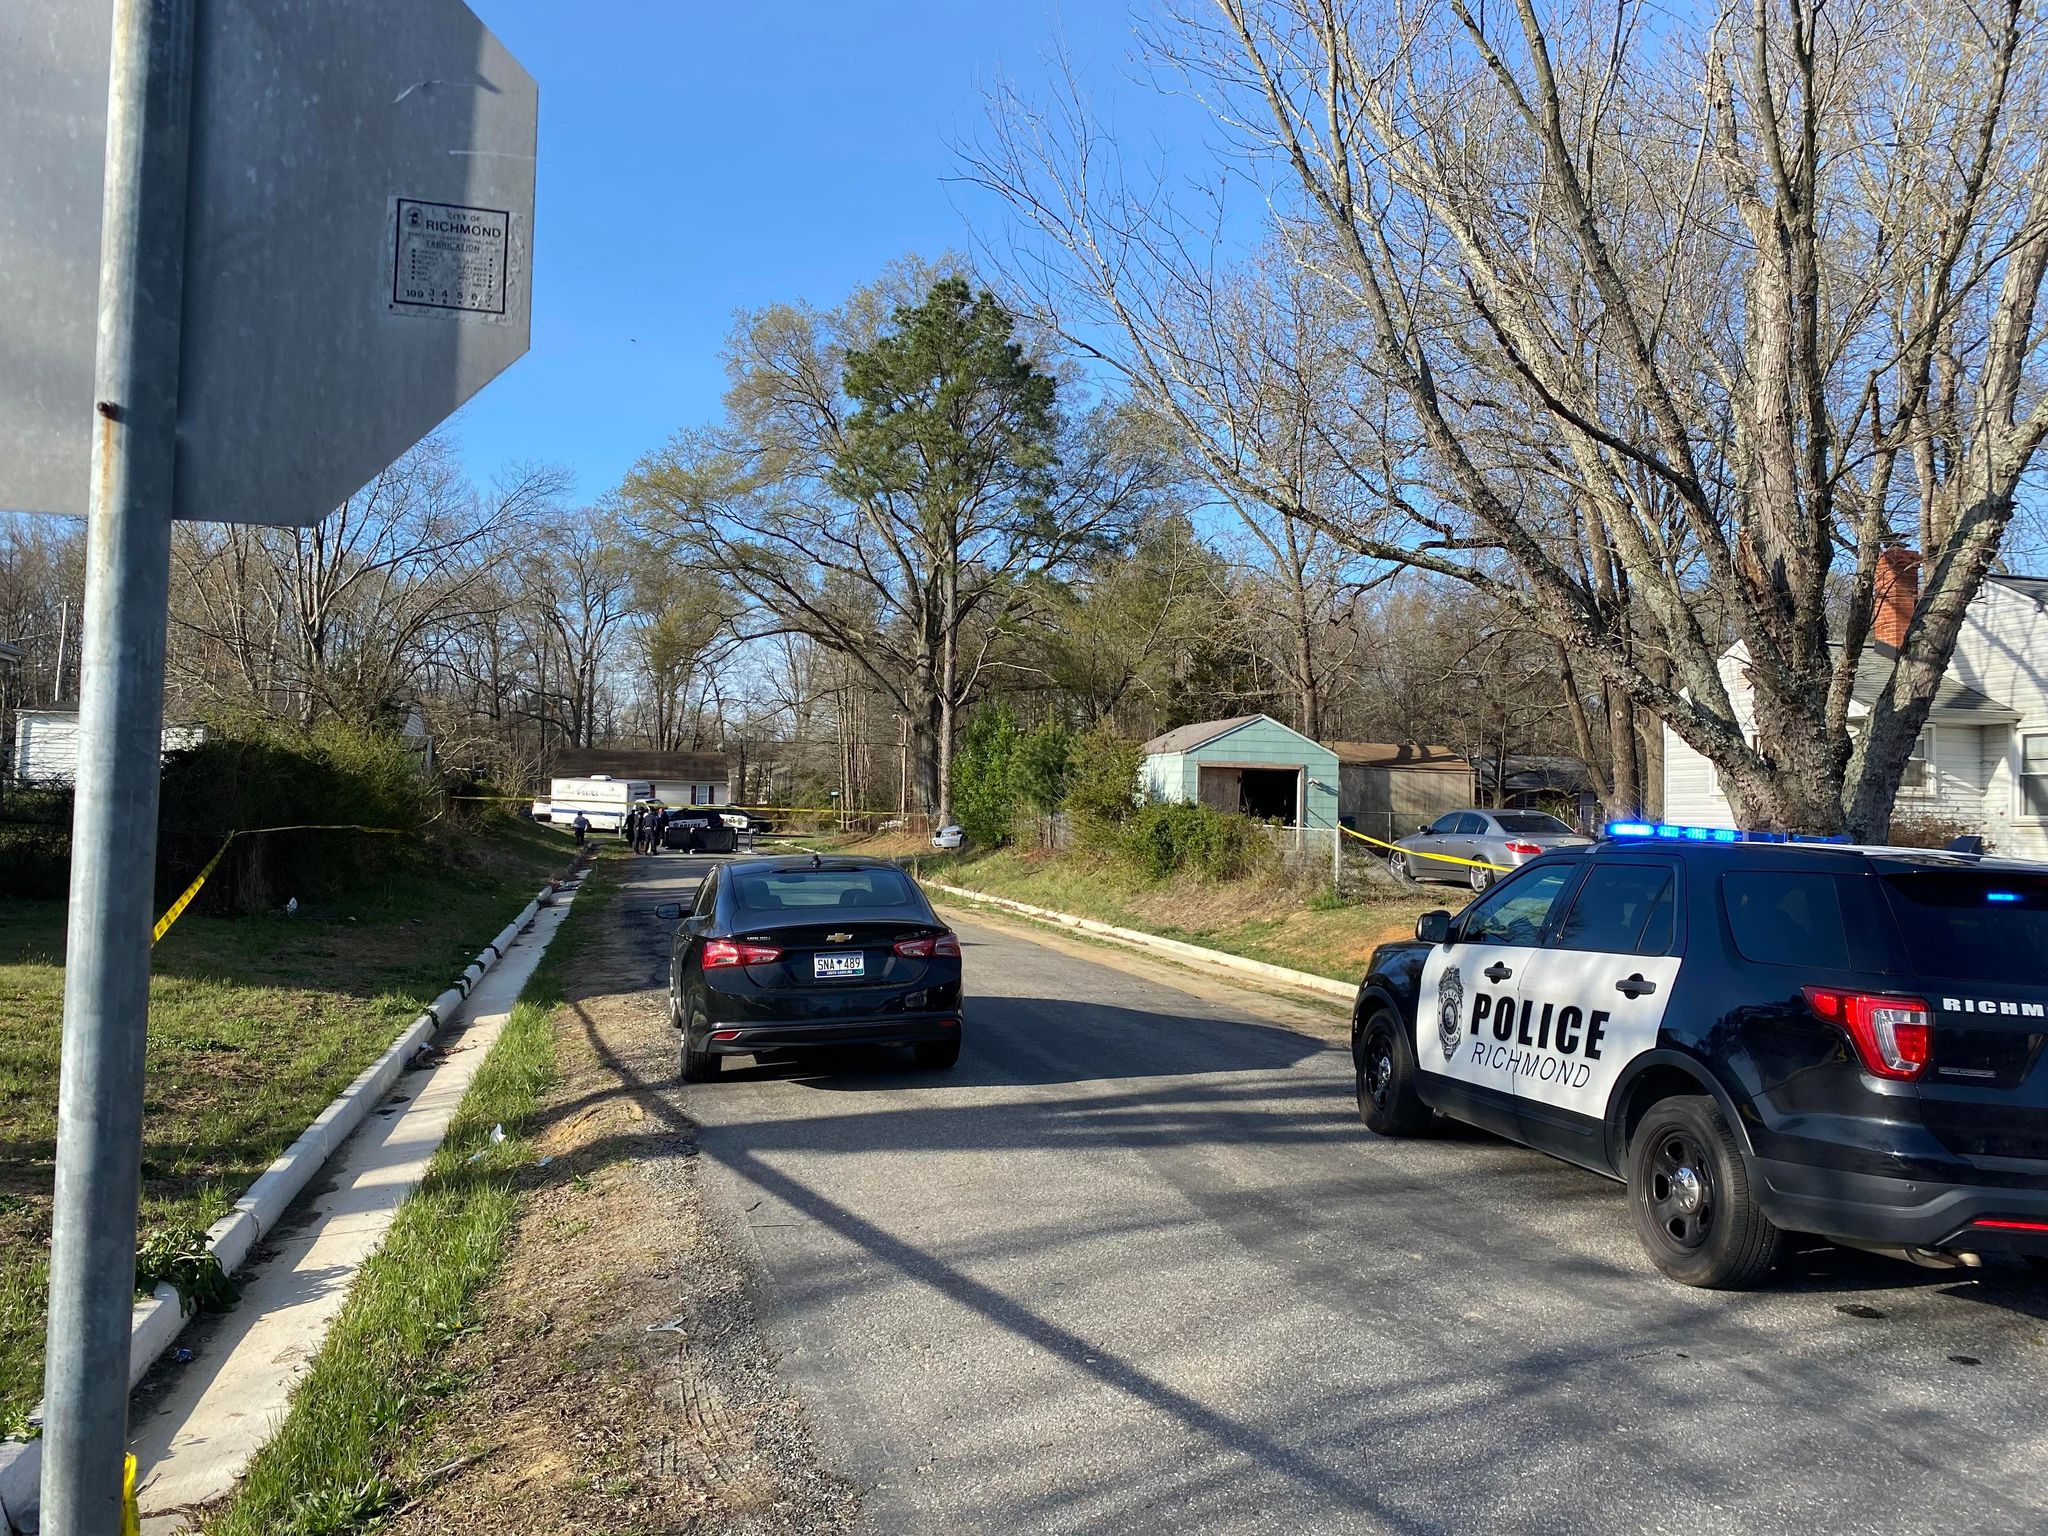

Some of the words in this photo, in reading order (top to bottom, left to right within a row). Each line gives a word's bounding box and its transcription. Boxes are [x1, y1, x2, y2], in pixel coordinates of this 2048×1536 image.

[447, 212, 467, 221] CITY
[426, 220, 501, 238] RICHMOND
[426, 240, 480, 252] FABRICATION
[406, 289, 424, 298] 199
[428, 289, 435, 297] 3
[441, 290, 448, 298] 4
[457, 291, 463, 299] 5
[817, 958, 835, 970] SNA
[844, 957, 861, 969] 489
[1942, 997, 2048, 1017] RICHM
[1470, 992, 1611, 1061] POLICE
[1471, 1041, 1591, 1088] RICHMOND
